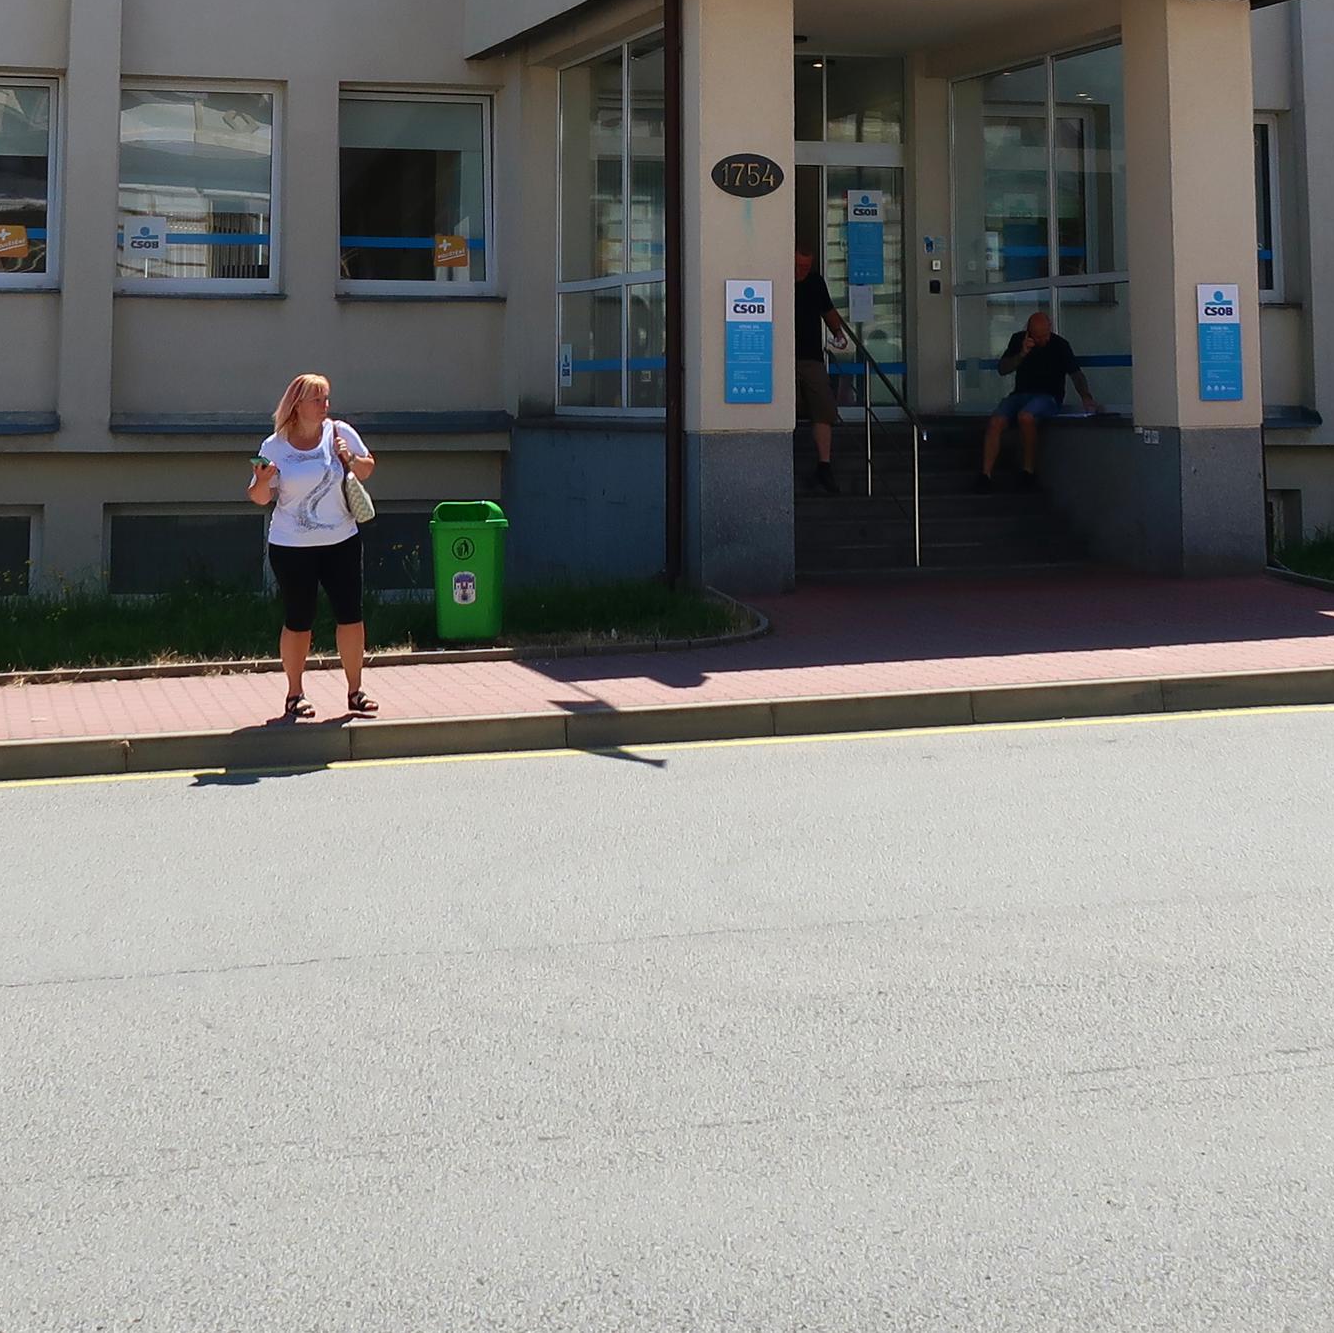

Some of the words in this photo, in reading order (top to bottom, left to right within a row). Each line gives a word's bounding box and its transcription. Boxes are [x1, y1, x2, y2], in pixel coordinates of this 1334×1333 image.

[722, 163, 776, 187] 1754
[130, 240, 160, 249] ČSOB
[733, 302, 765, 314] ČSOB
[1204, 306, 1233, 316] ČSOB
